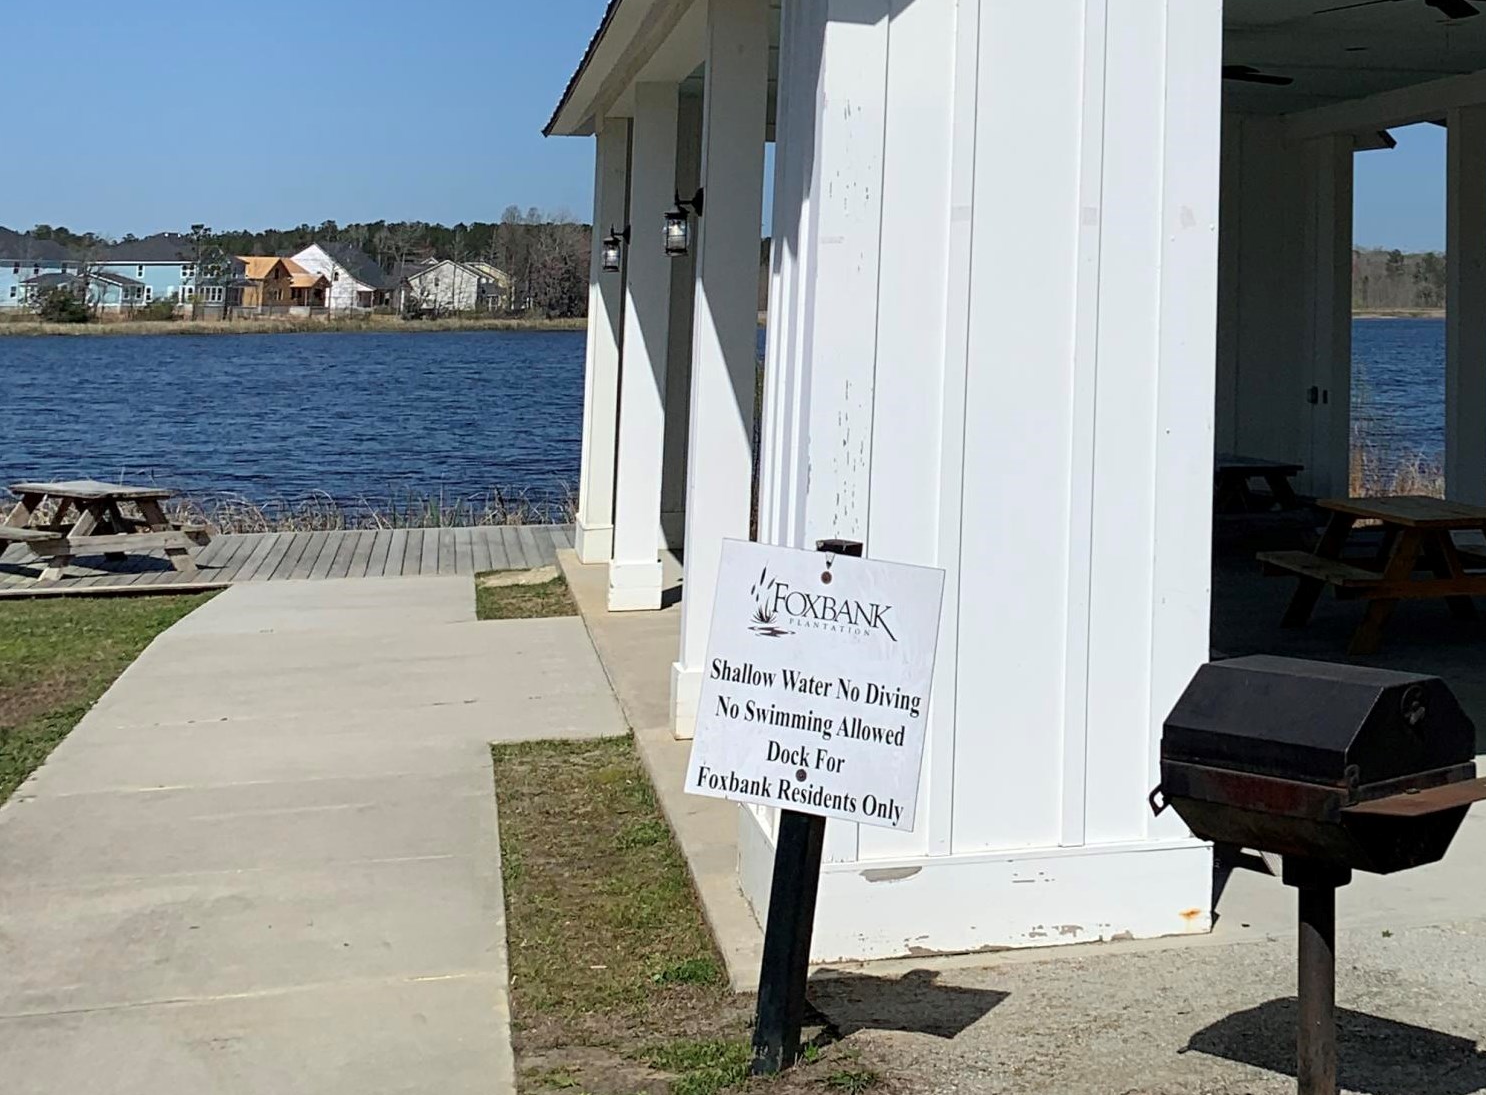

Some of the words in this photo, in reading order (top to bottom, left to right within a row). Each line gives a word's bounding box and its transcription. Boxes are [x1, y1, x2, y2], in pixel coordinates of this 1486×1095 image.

[773, 582, 898, 642] FOXBANK
[789, 618, 871, 637] PLANTATION
[710, 658, 776, 688] Shallow
[782, 669, 832, 697] Water
[836, 678, 860, 702] No
[866, 683, 921, 718] Diving
[715, 695, 739, 719] No
[744, 700, 833, 740] Swimming
[836, 717, 905, 747] Allowed
[767, 740, 809, 768] Dock
[815, 750, 845, 773] For
[697, 766, 771, 798] Foxbank
[777, 779, 857, 813] Residents
[862, 795, 904, 826] Only
